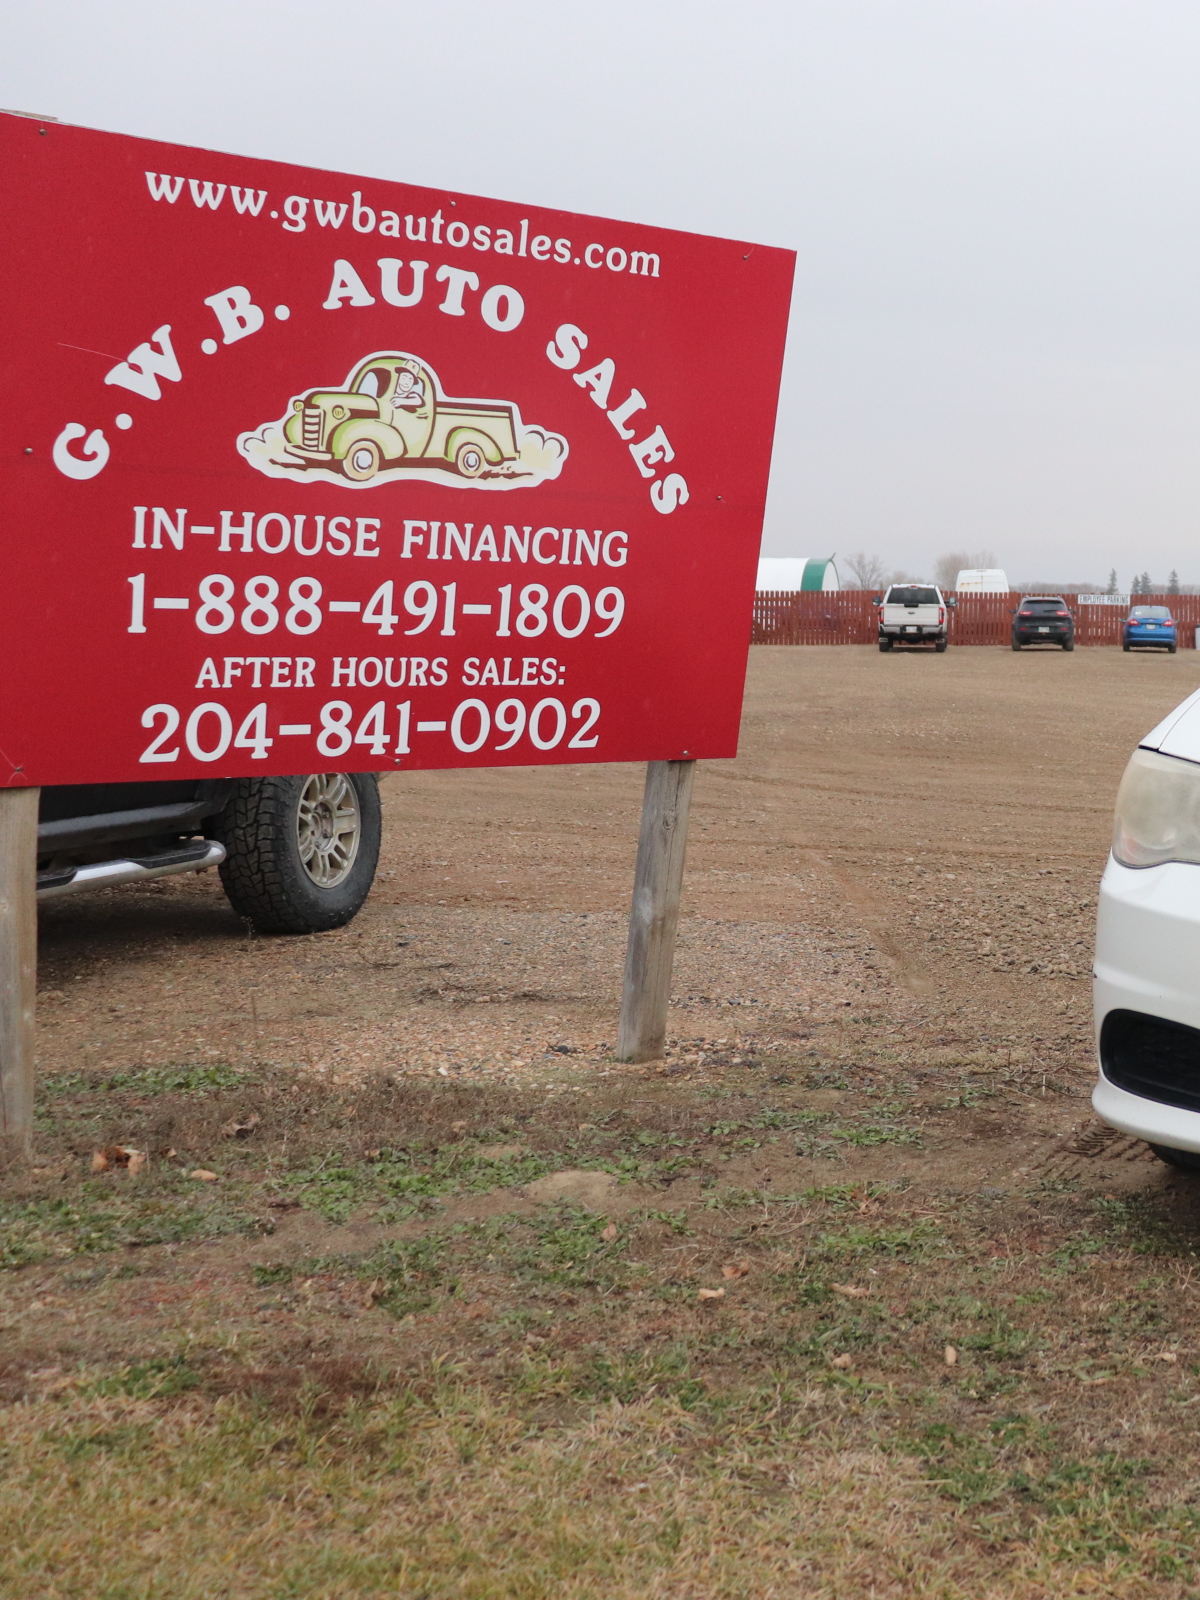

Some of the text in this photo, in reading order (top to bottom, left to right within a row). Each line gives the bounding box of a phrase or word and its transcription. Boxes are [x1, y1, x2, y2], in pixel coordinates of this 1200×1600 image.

[145, 172, 660, 277] www.gwbautosales.com
[53, 258, 690, 514] G.W.B. AUTO SALES
[132, 506, 629, 567] IN-HOUSE FINANCING
[128, 573, 625, 638] 1-888-491-1809
[195, 657, 566, 688] AFTER HOURS SALES:
[139, 698, 600, 763] 204-841-0902
